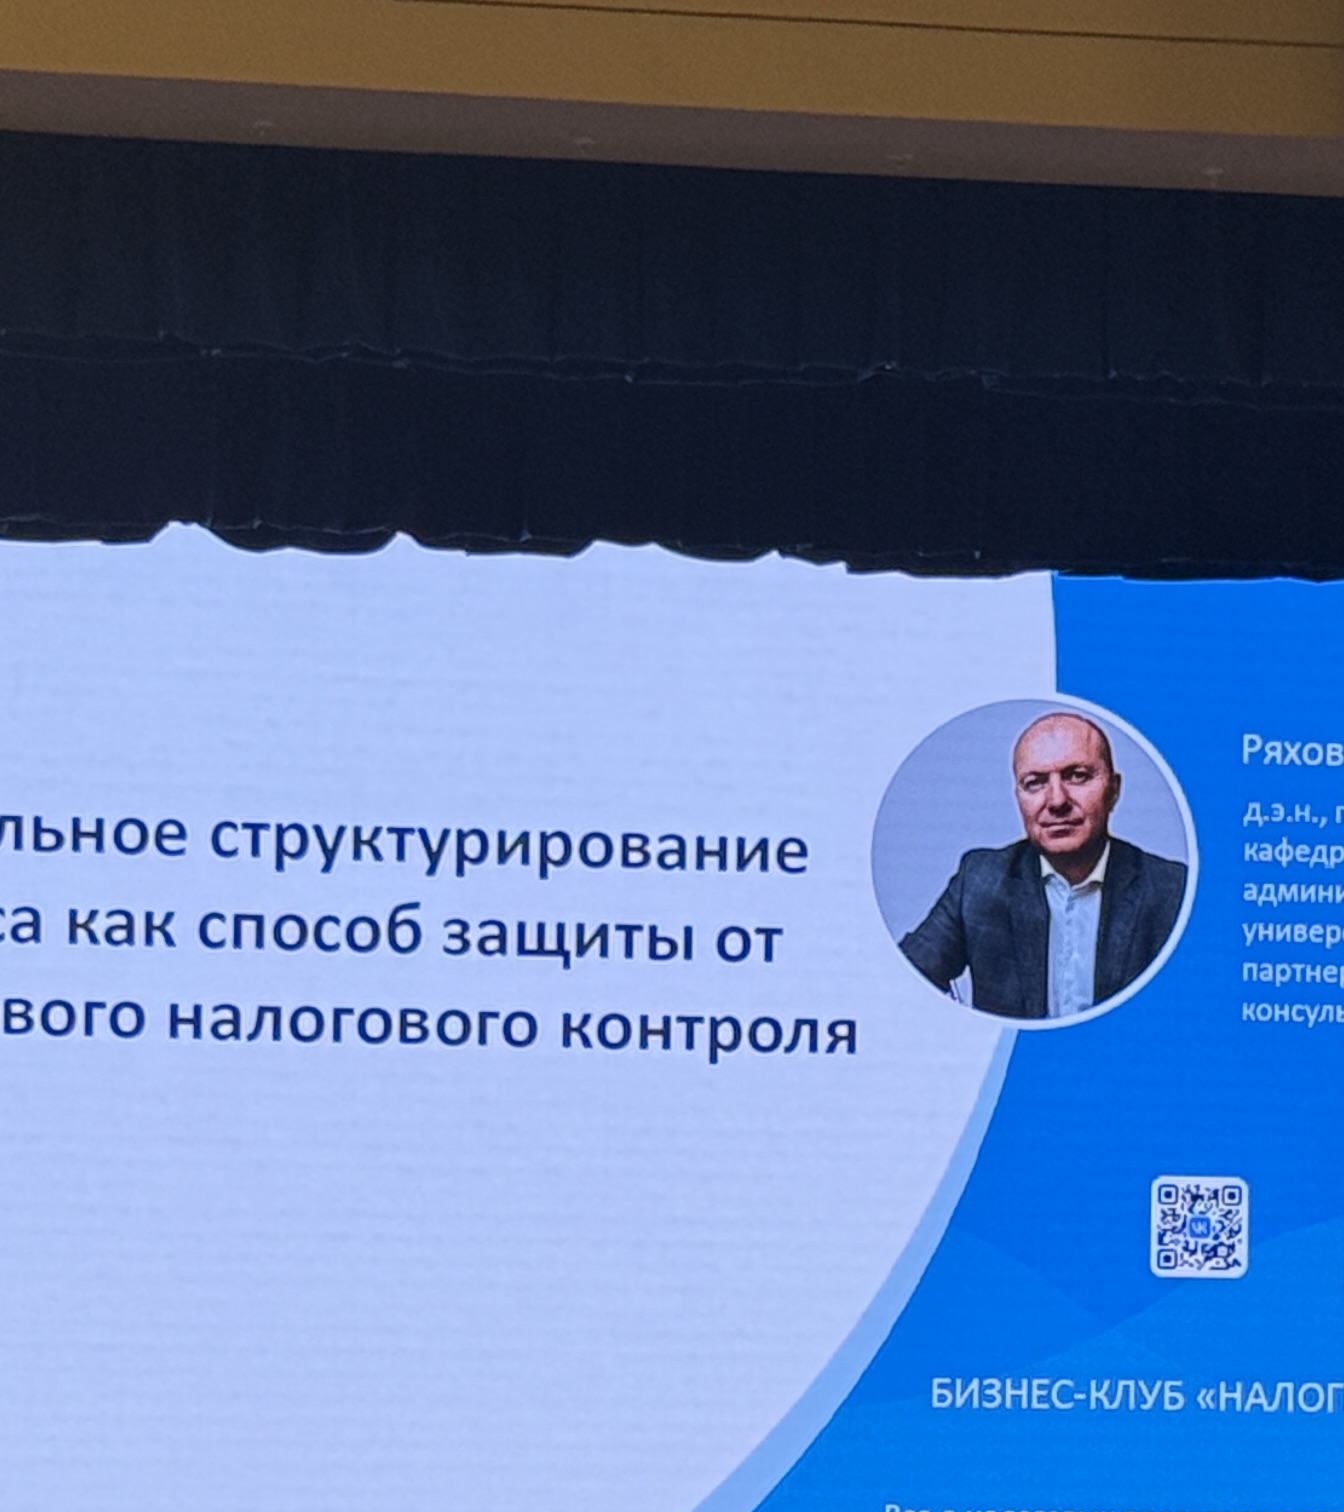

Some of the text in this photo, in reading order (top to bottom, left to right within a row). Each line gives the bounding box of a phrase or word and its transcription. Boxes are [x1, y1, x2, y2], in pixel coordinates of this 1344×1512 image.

[1242, 802, 1328, 829] д.э.н.,
[210, 819, 810, 881] структурирование
[67, 907, 178, 949] как
[197, 900, 423, 956] способ
[441, 917, 694, 971] защиты
[715, 924, 785, 964] от
[168, 1002, 539, 1049] налогового
[561, 1011, 858, 1066] контроля
[930, 1376, 1186, 1412] БИЗНЕС-КЛУБ
